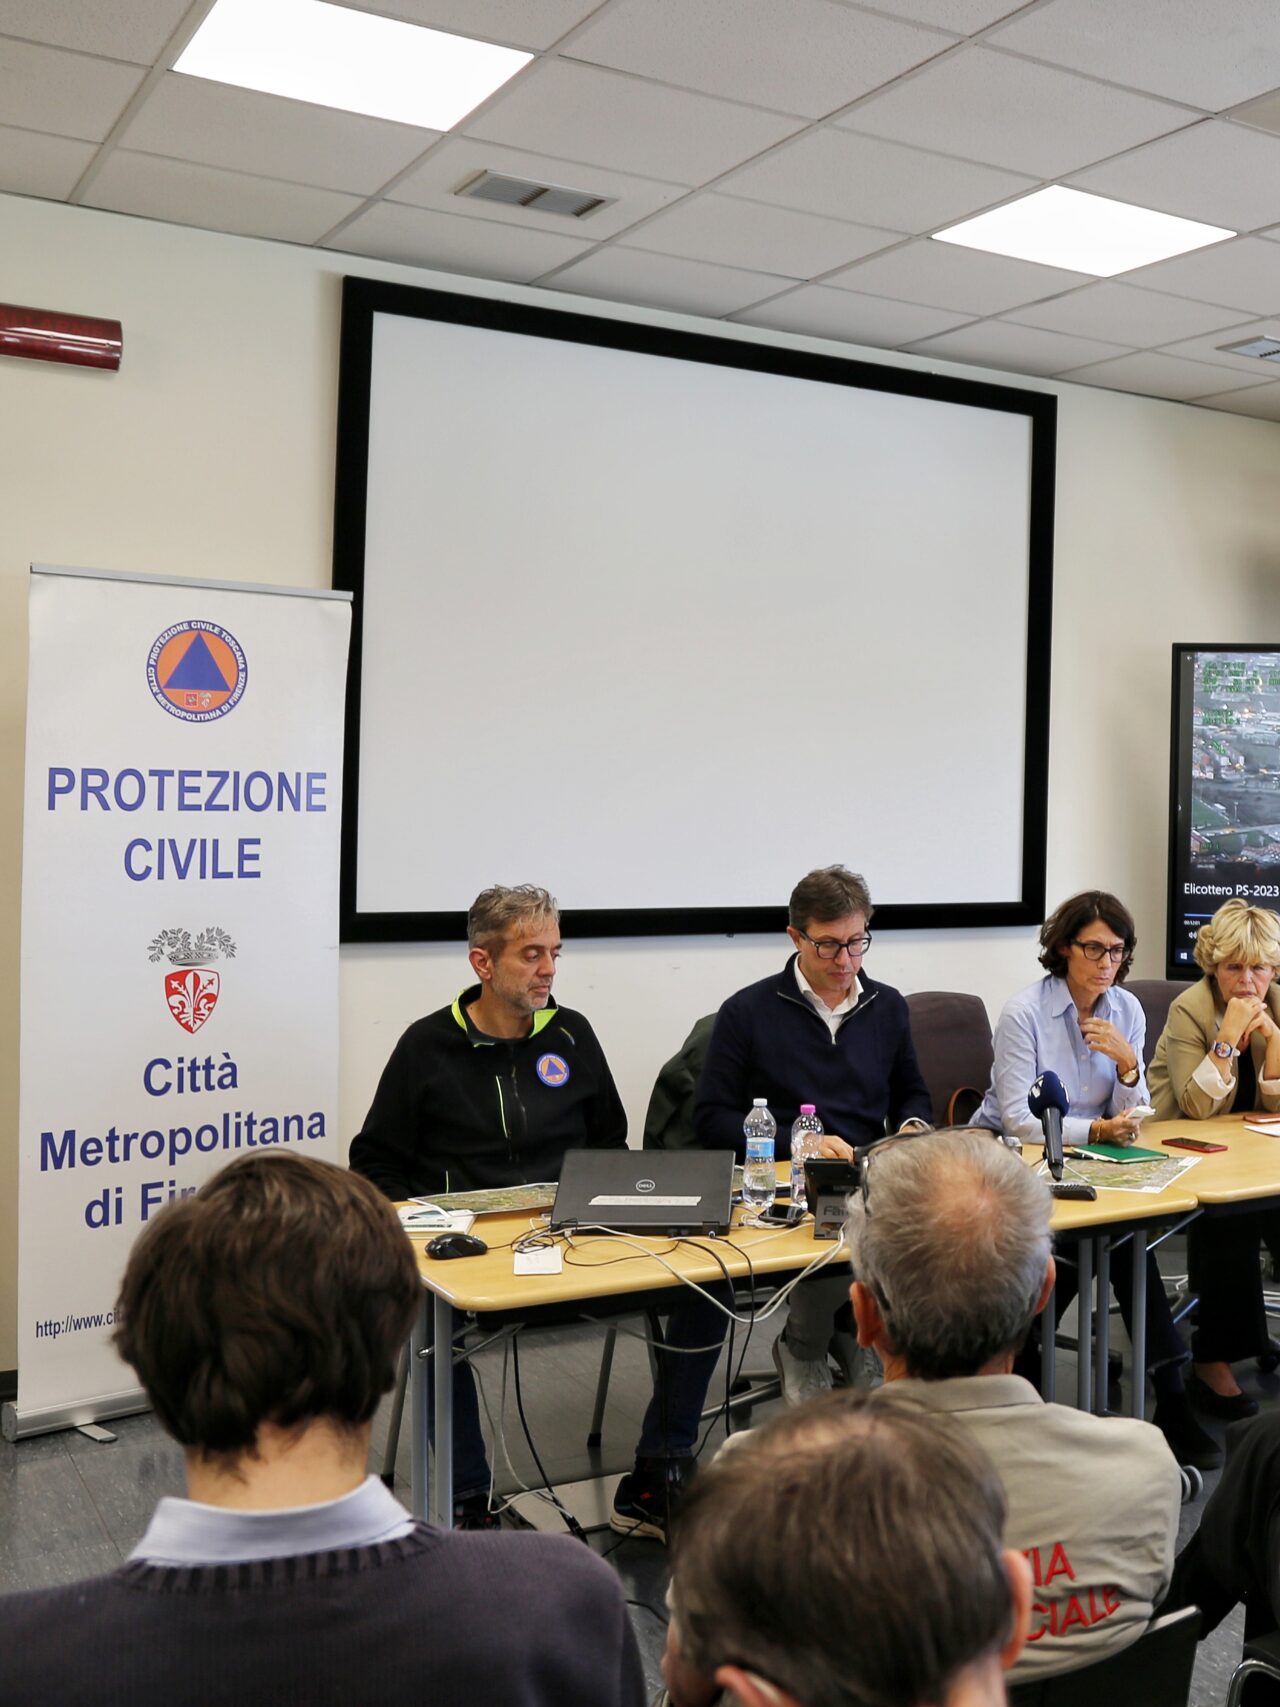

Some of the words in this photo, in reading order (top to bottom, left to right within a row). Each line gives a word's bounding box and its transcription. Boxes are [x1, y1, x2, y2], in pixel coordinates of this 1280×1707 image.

[149, 622, 189, 665] PROTEZIONE
[191, 621, 220, 634] CIVILE
[221, 630, 245, 670] TOSCANA
[156, 693, 221, 721] METROPOLITANA
[221, 702, 231, 711] DI
[228, 672, 245, 706] FIRENZE
[47, 767, 327, 812] PROTEZIONE
[124, 838, 261, 882] CIVILE
[1184, 883, 1233, 896] Elicottero
[143, 1052, 239, 1096] Città
[40, 1111, 327, 1172] Metropolitana
[85, 1187, 122, 1229] di
